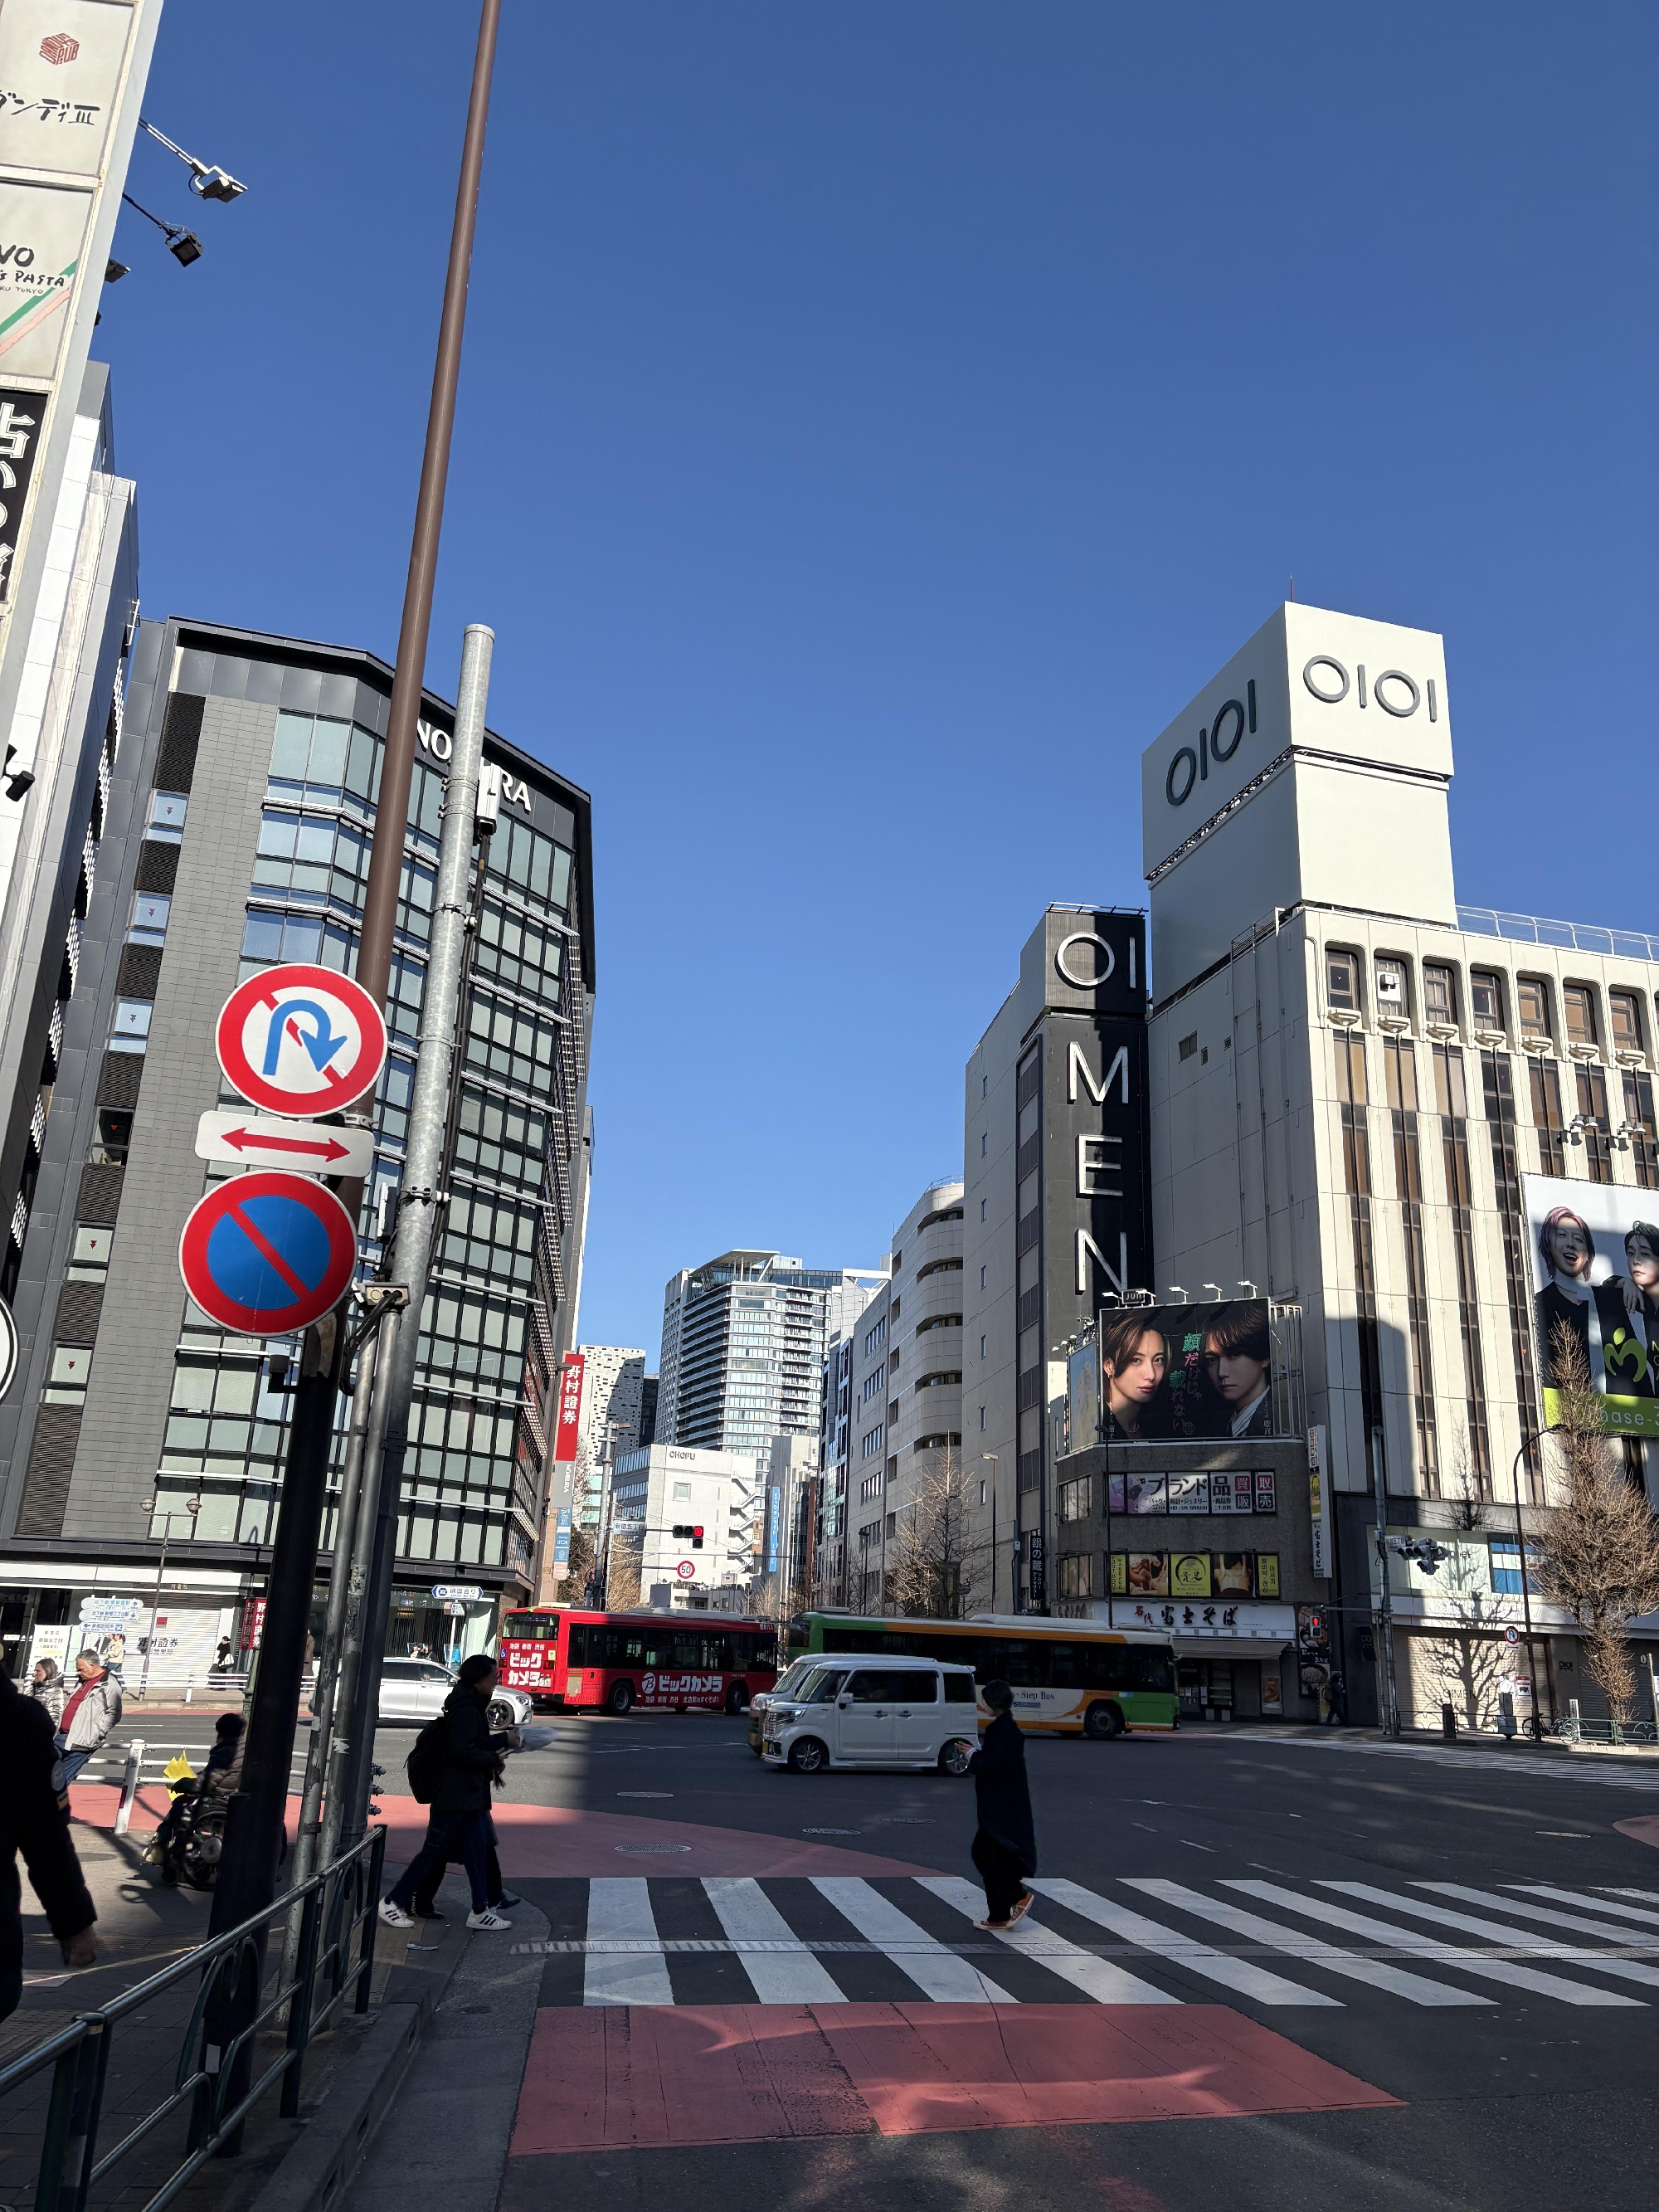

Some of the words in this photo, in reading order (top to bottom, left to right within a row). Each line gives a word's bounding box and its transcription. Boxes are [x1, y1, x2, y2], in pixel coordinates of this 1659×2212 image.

[15, 270, 65, 287] PASTA
[1067, 1040, 1129, 1296] MEN
[562, 1365, 581, 1425] 野村證券
[669, 1450, 696, 1460] CHOFU
[1148, 1475, 1231, 1496] ブランド品
[1032, 1537, 1042, 1571] 銀の蔵
[681, 1565, 691, 1574] 50
[1161, 1605, 1238, 1626] 富士そば
[509, 1652, 542, 1669] ビック
[508, 1670, 541, 1687] カメラ
[659, 1675, 722, 1693] ビックカメラ
